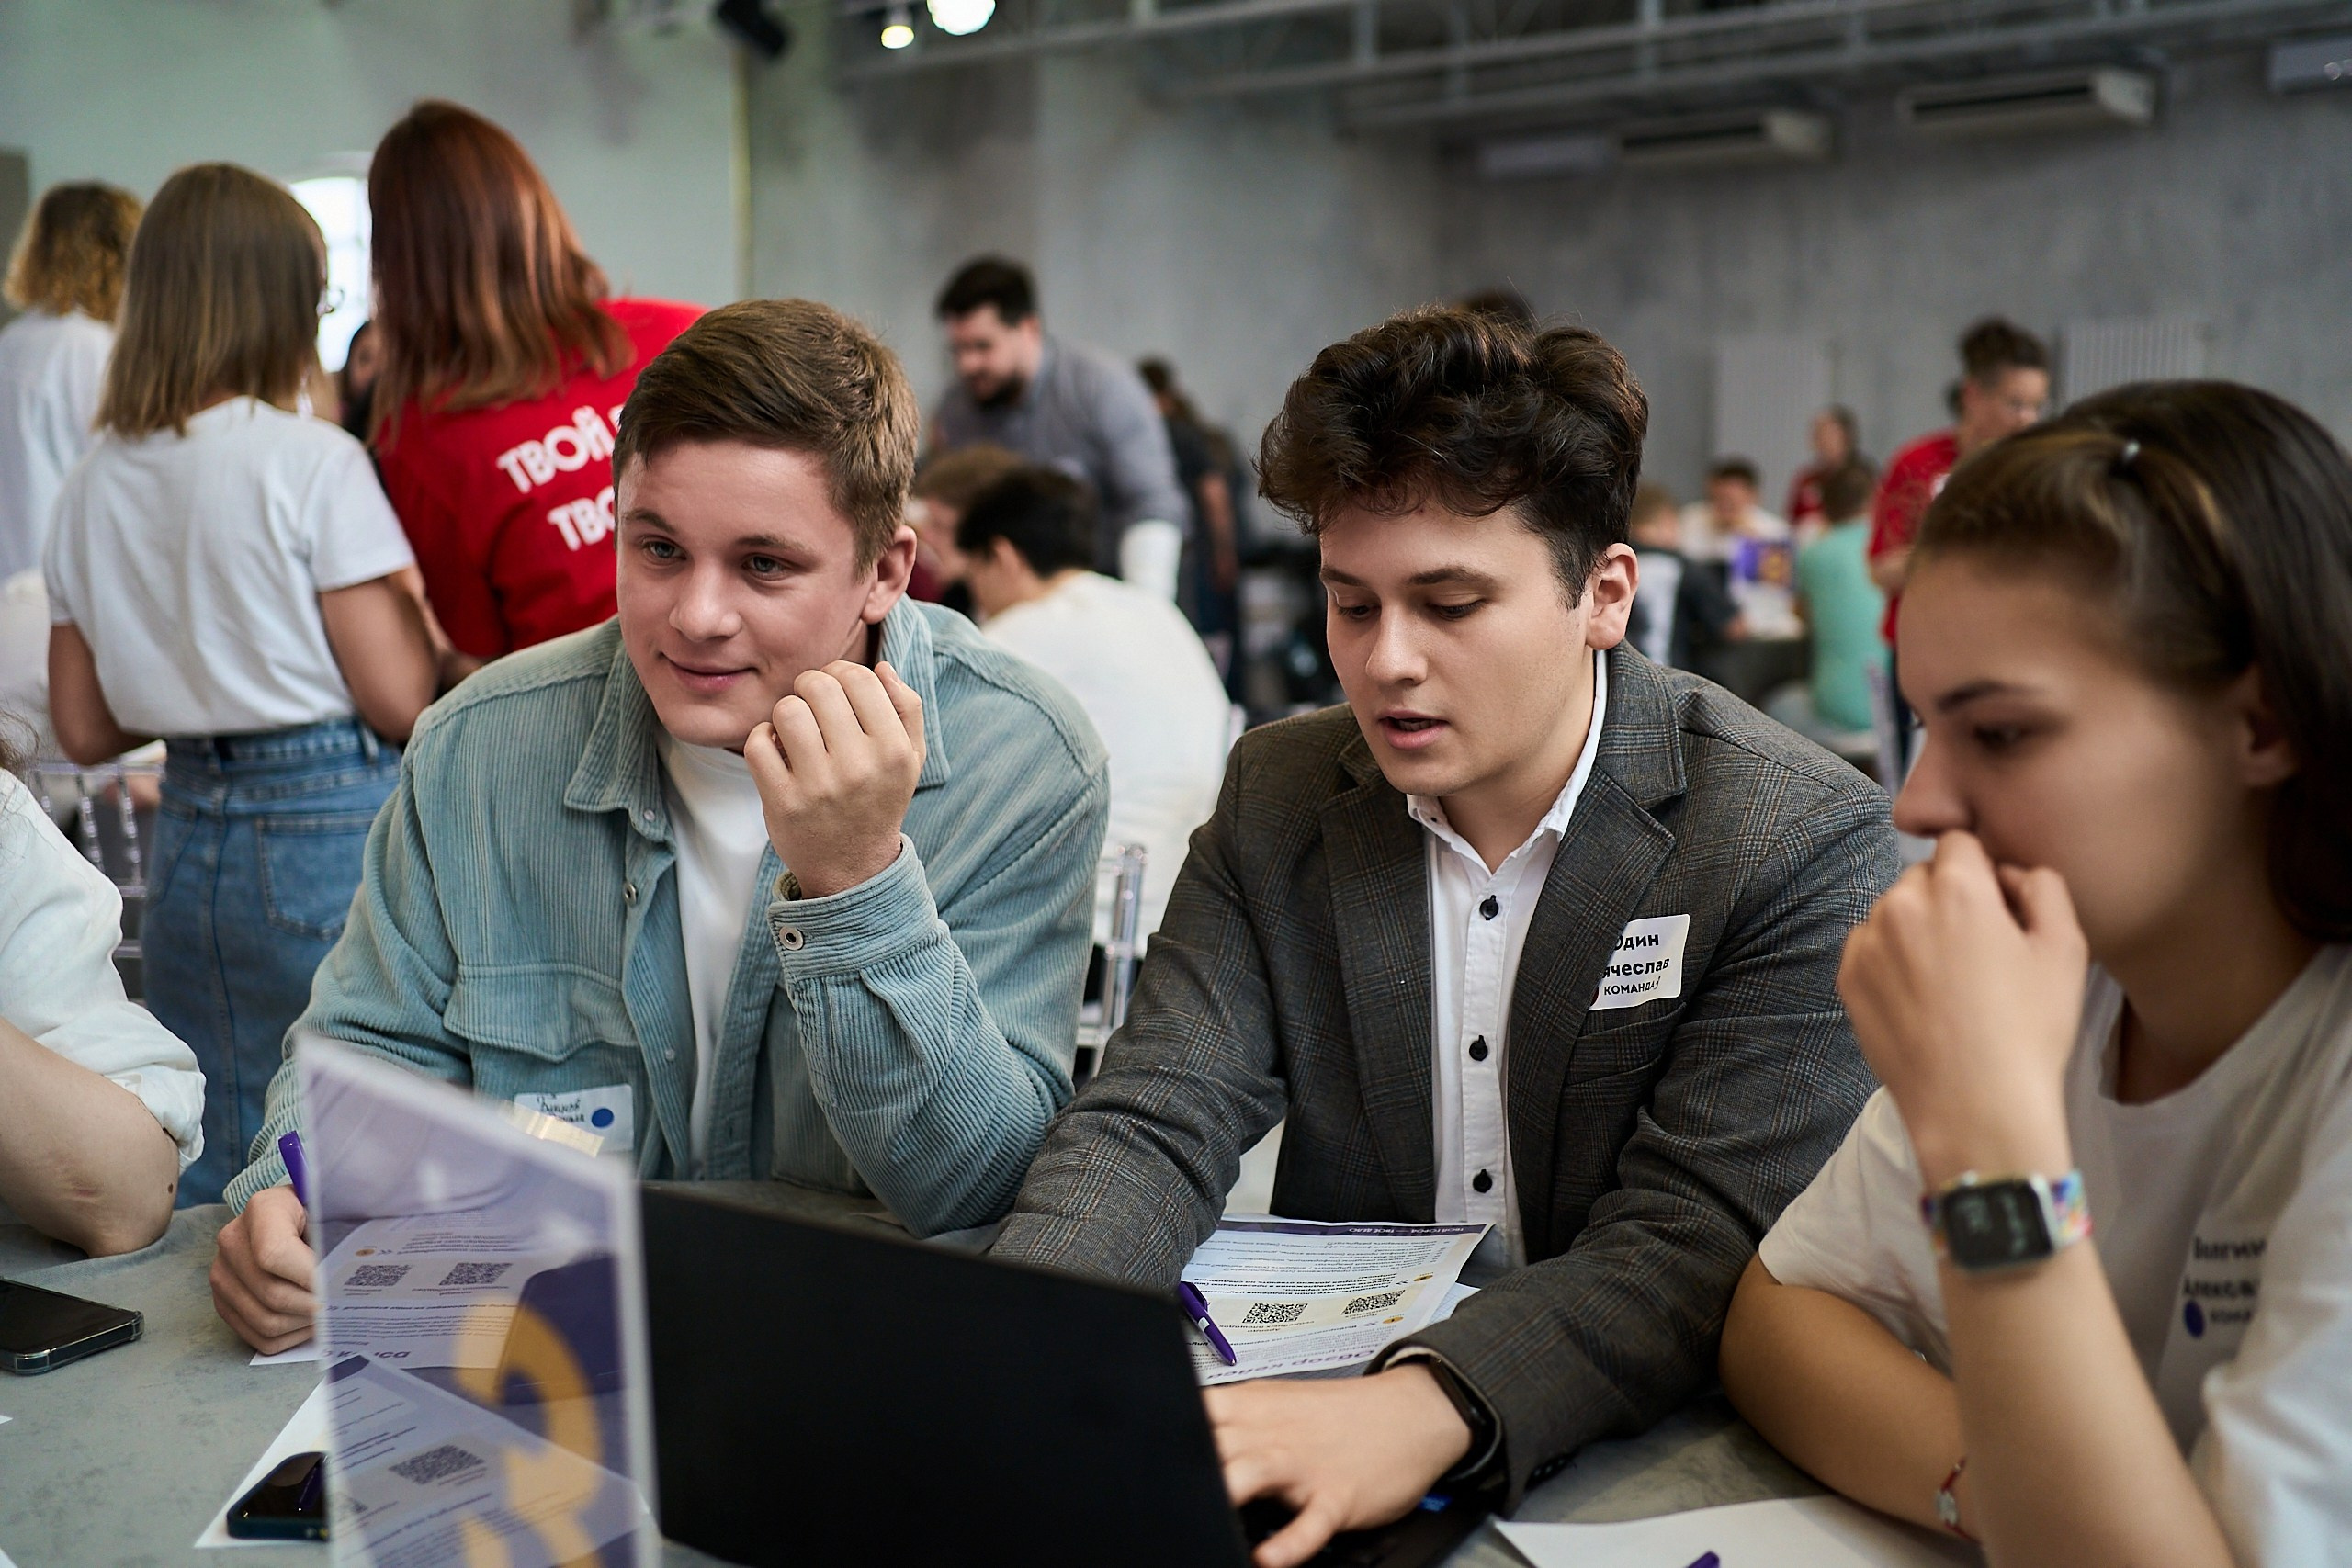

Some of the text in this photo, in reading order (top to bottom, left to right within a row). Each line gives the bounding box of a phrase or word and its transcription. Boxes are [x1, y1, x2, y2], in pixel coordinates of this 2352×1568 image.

[496, 405, 615, 494] ТВОЙ
[1291, 1349, 1374, 1366] Обзор
[1206, 1363, 1283, 1378] кейса
